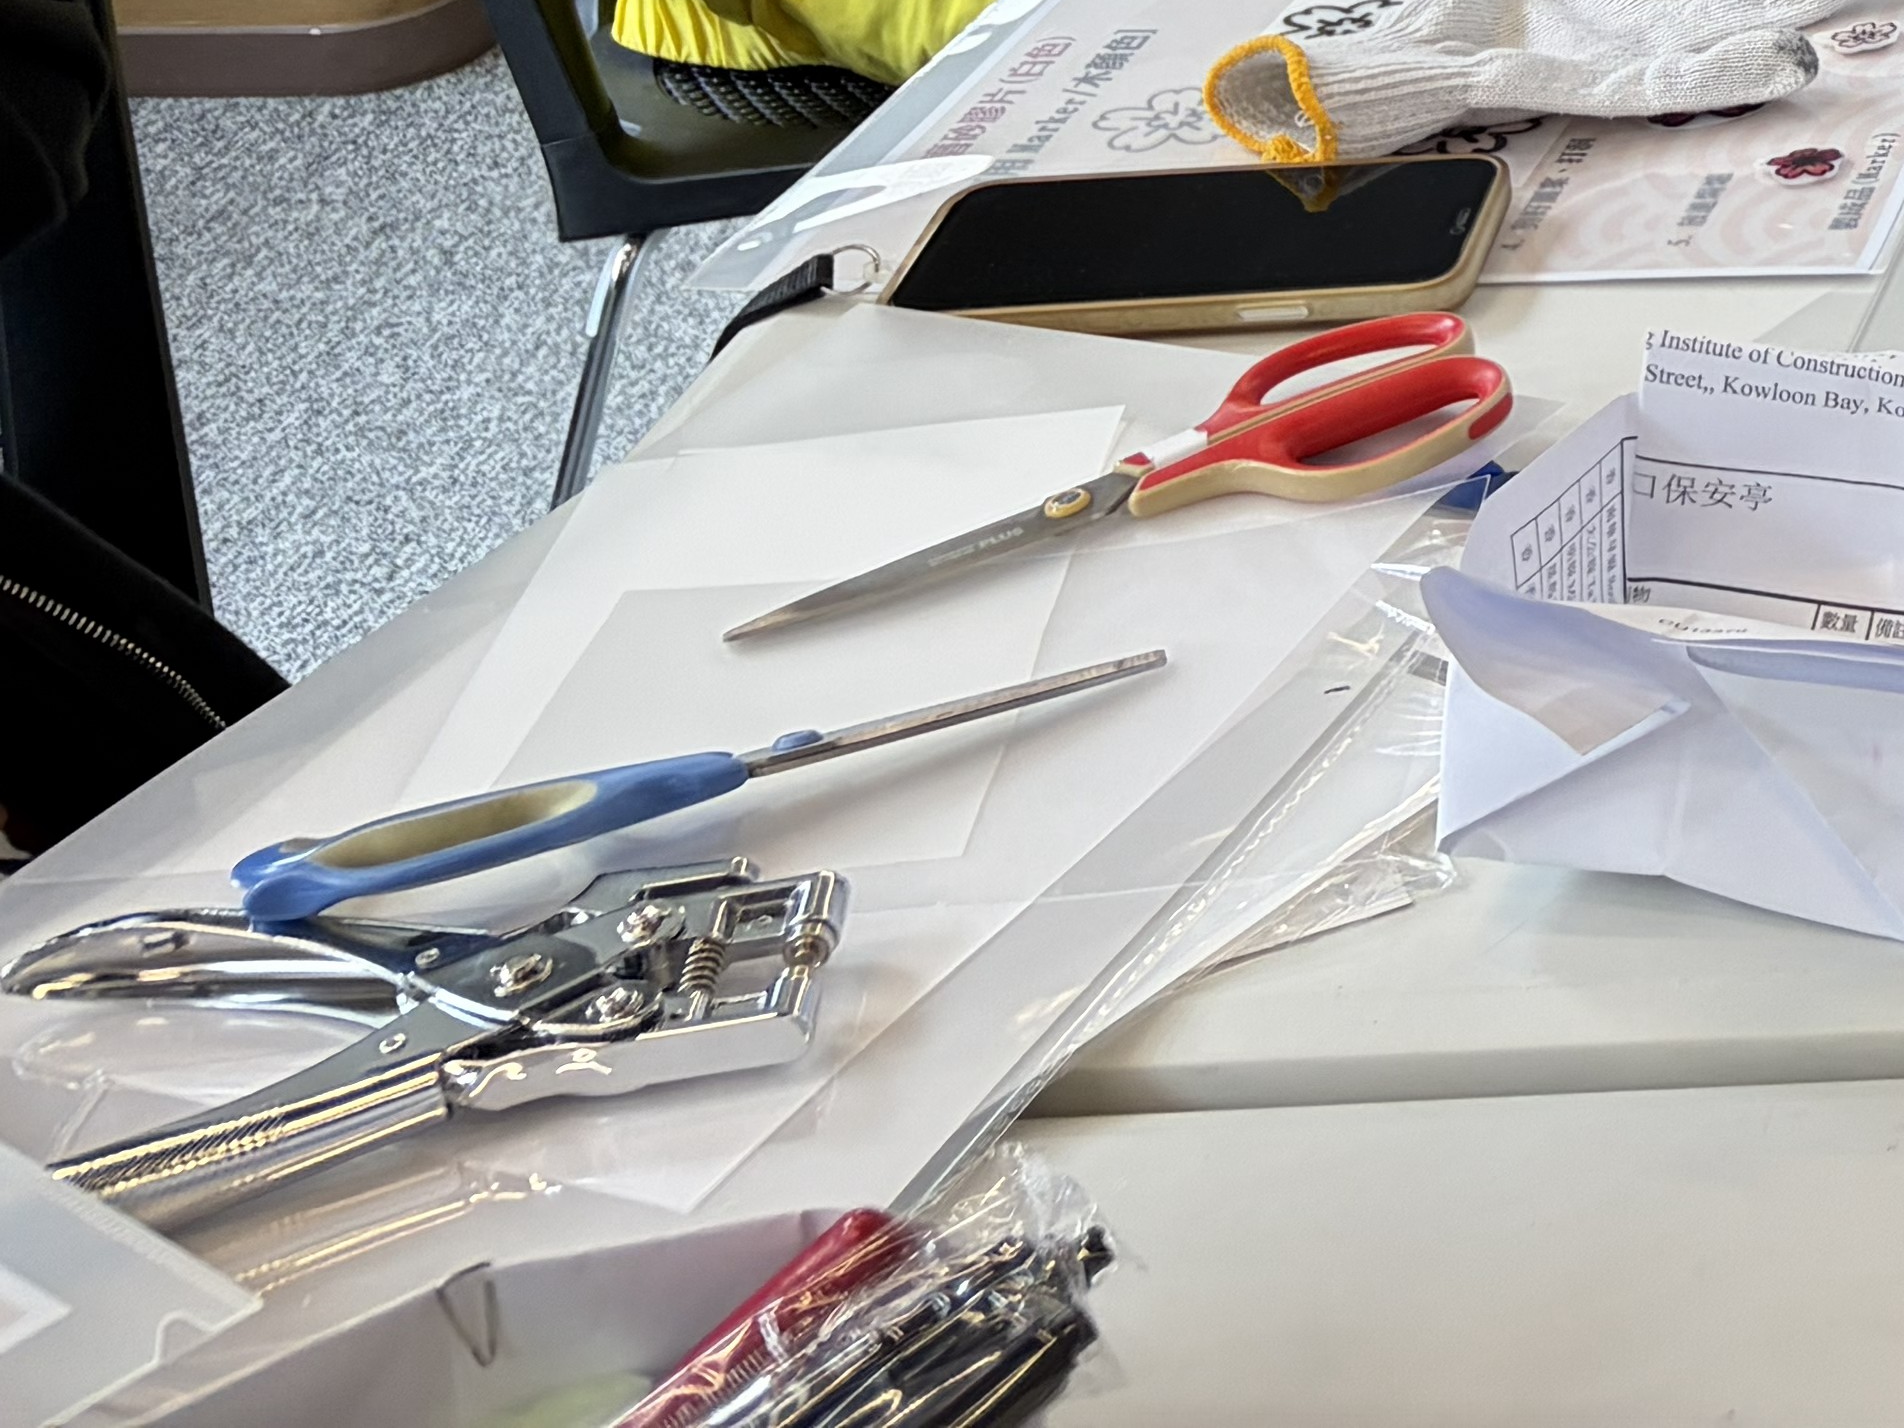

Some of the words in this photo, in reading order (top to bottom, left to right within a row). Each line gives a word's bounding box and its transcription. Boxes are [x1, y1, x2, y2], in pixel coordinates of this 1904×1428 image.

[1660, 329, 1744, 362] Institute
[1748, 347, 1771, 366] of
[1644, 363, 1716, 396] Street,,
[1721, 375, 1818, 409] Kowloon
[1822, 390, 1870, 415] Bay,
[1820, 610, 1859, 635] 數量
